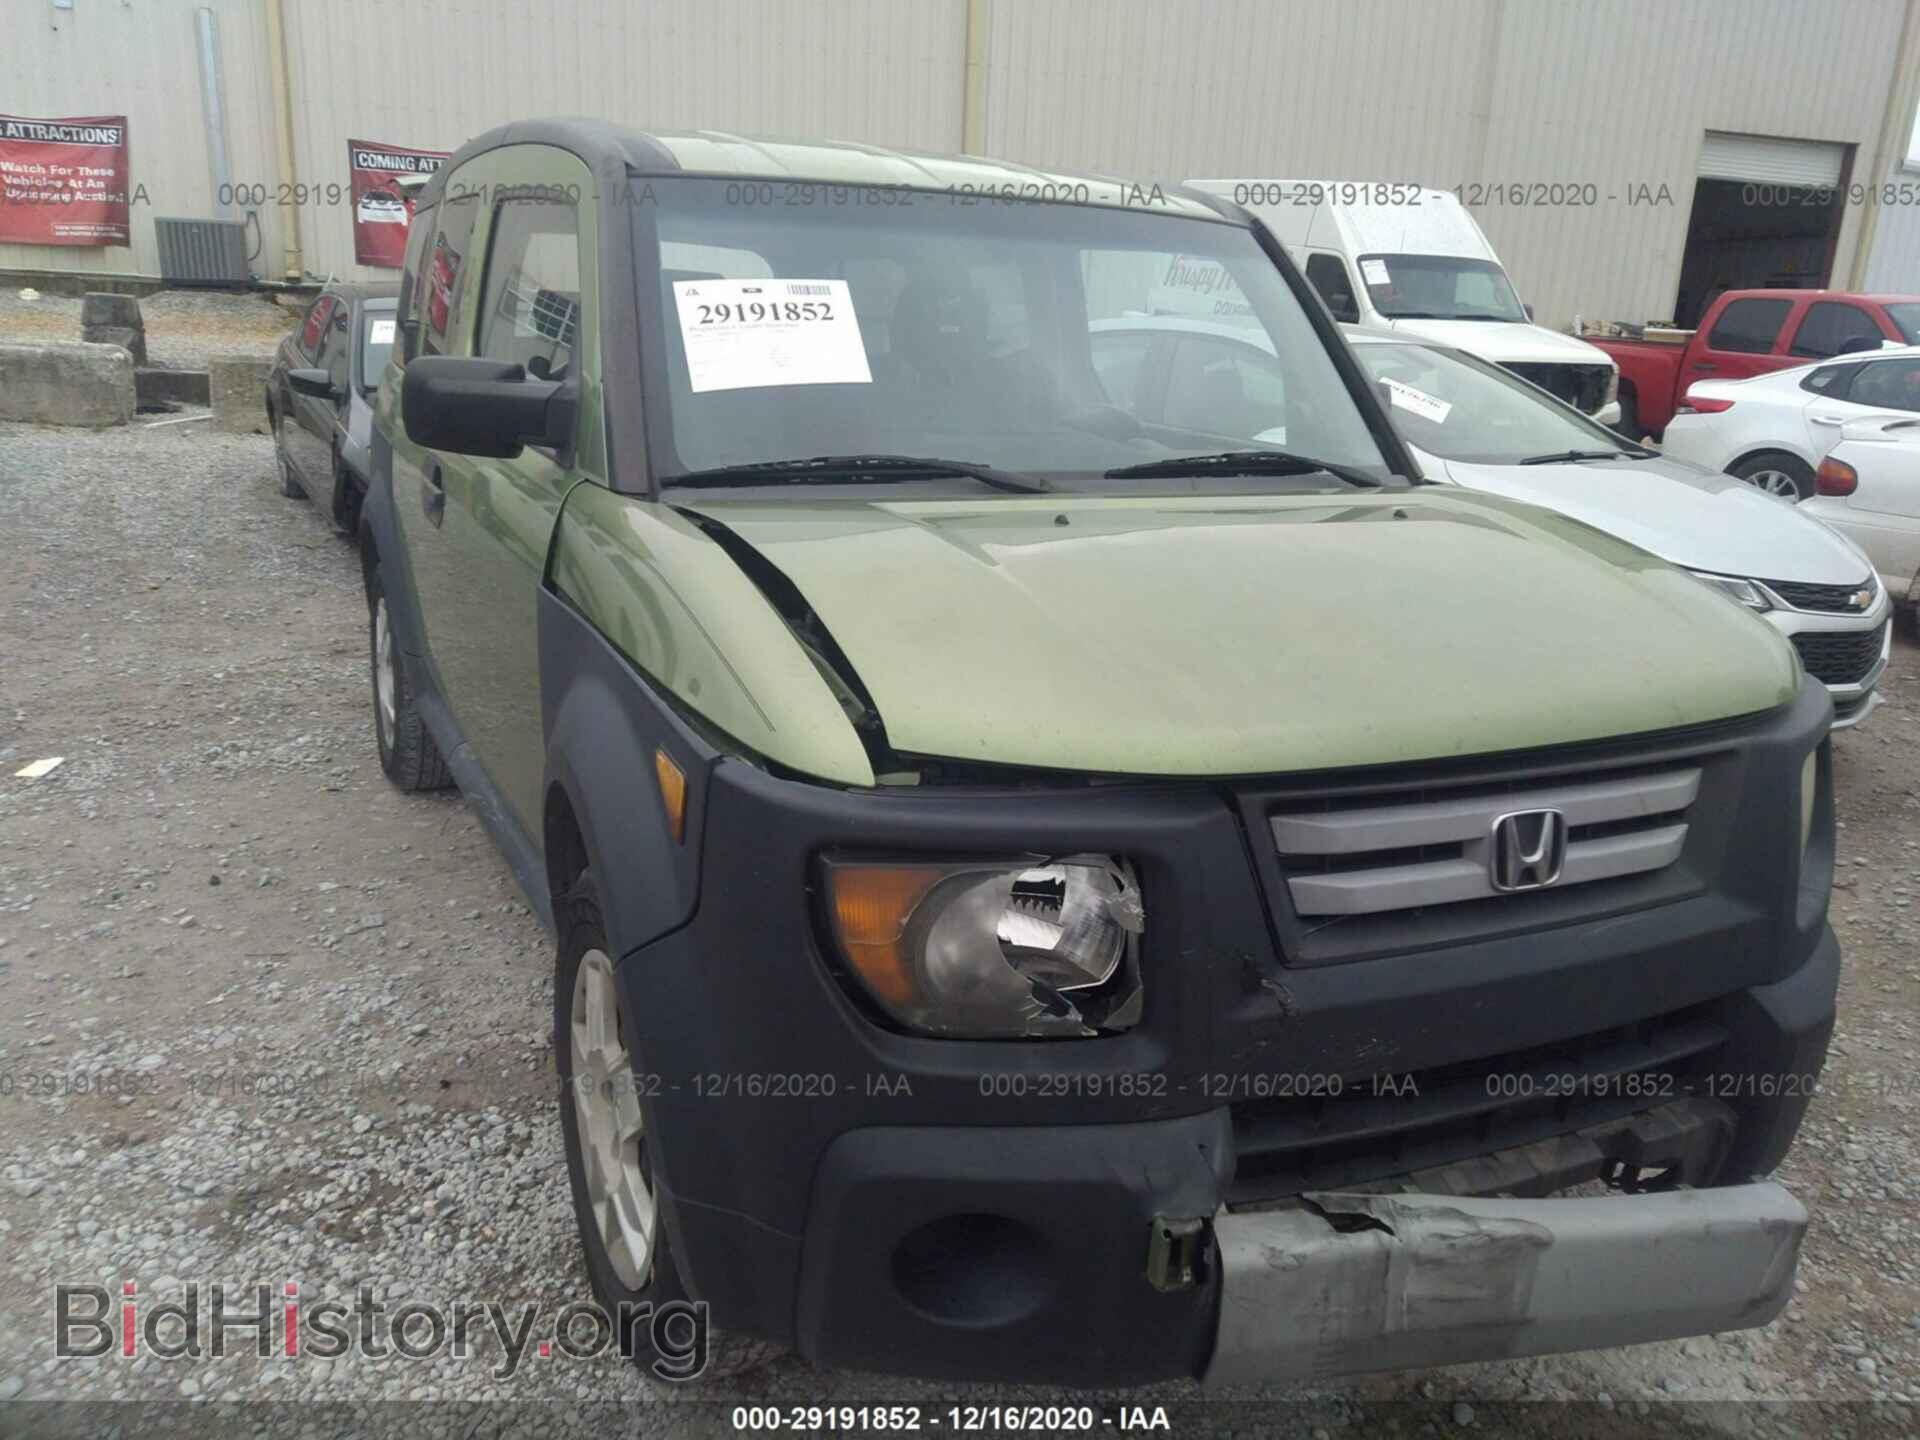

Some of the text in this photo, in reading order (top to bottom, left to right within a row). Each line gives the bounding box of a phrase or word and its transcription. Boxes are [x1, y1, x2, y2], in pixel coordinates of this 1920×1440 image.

[6, 122, 118, 144] ATTRACTIONS
[0, 161, 114, 178] Watch For These
[358, 152, 416, 171] COMING
[68, 178, 83, 189] At
[86, 178, 105, 189] An
[697, 302, 834, 325] 29191852
